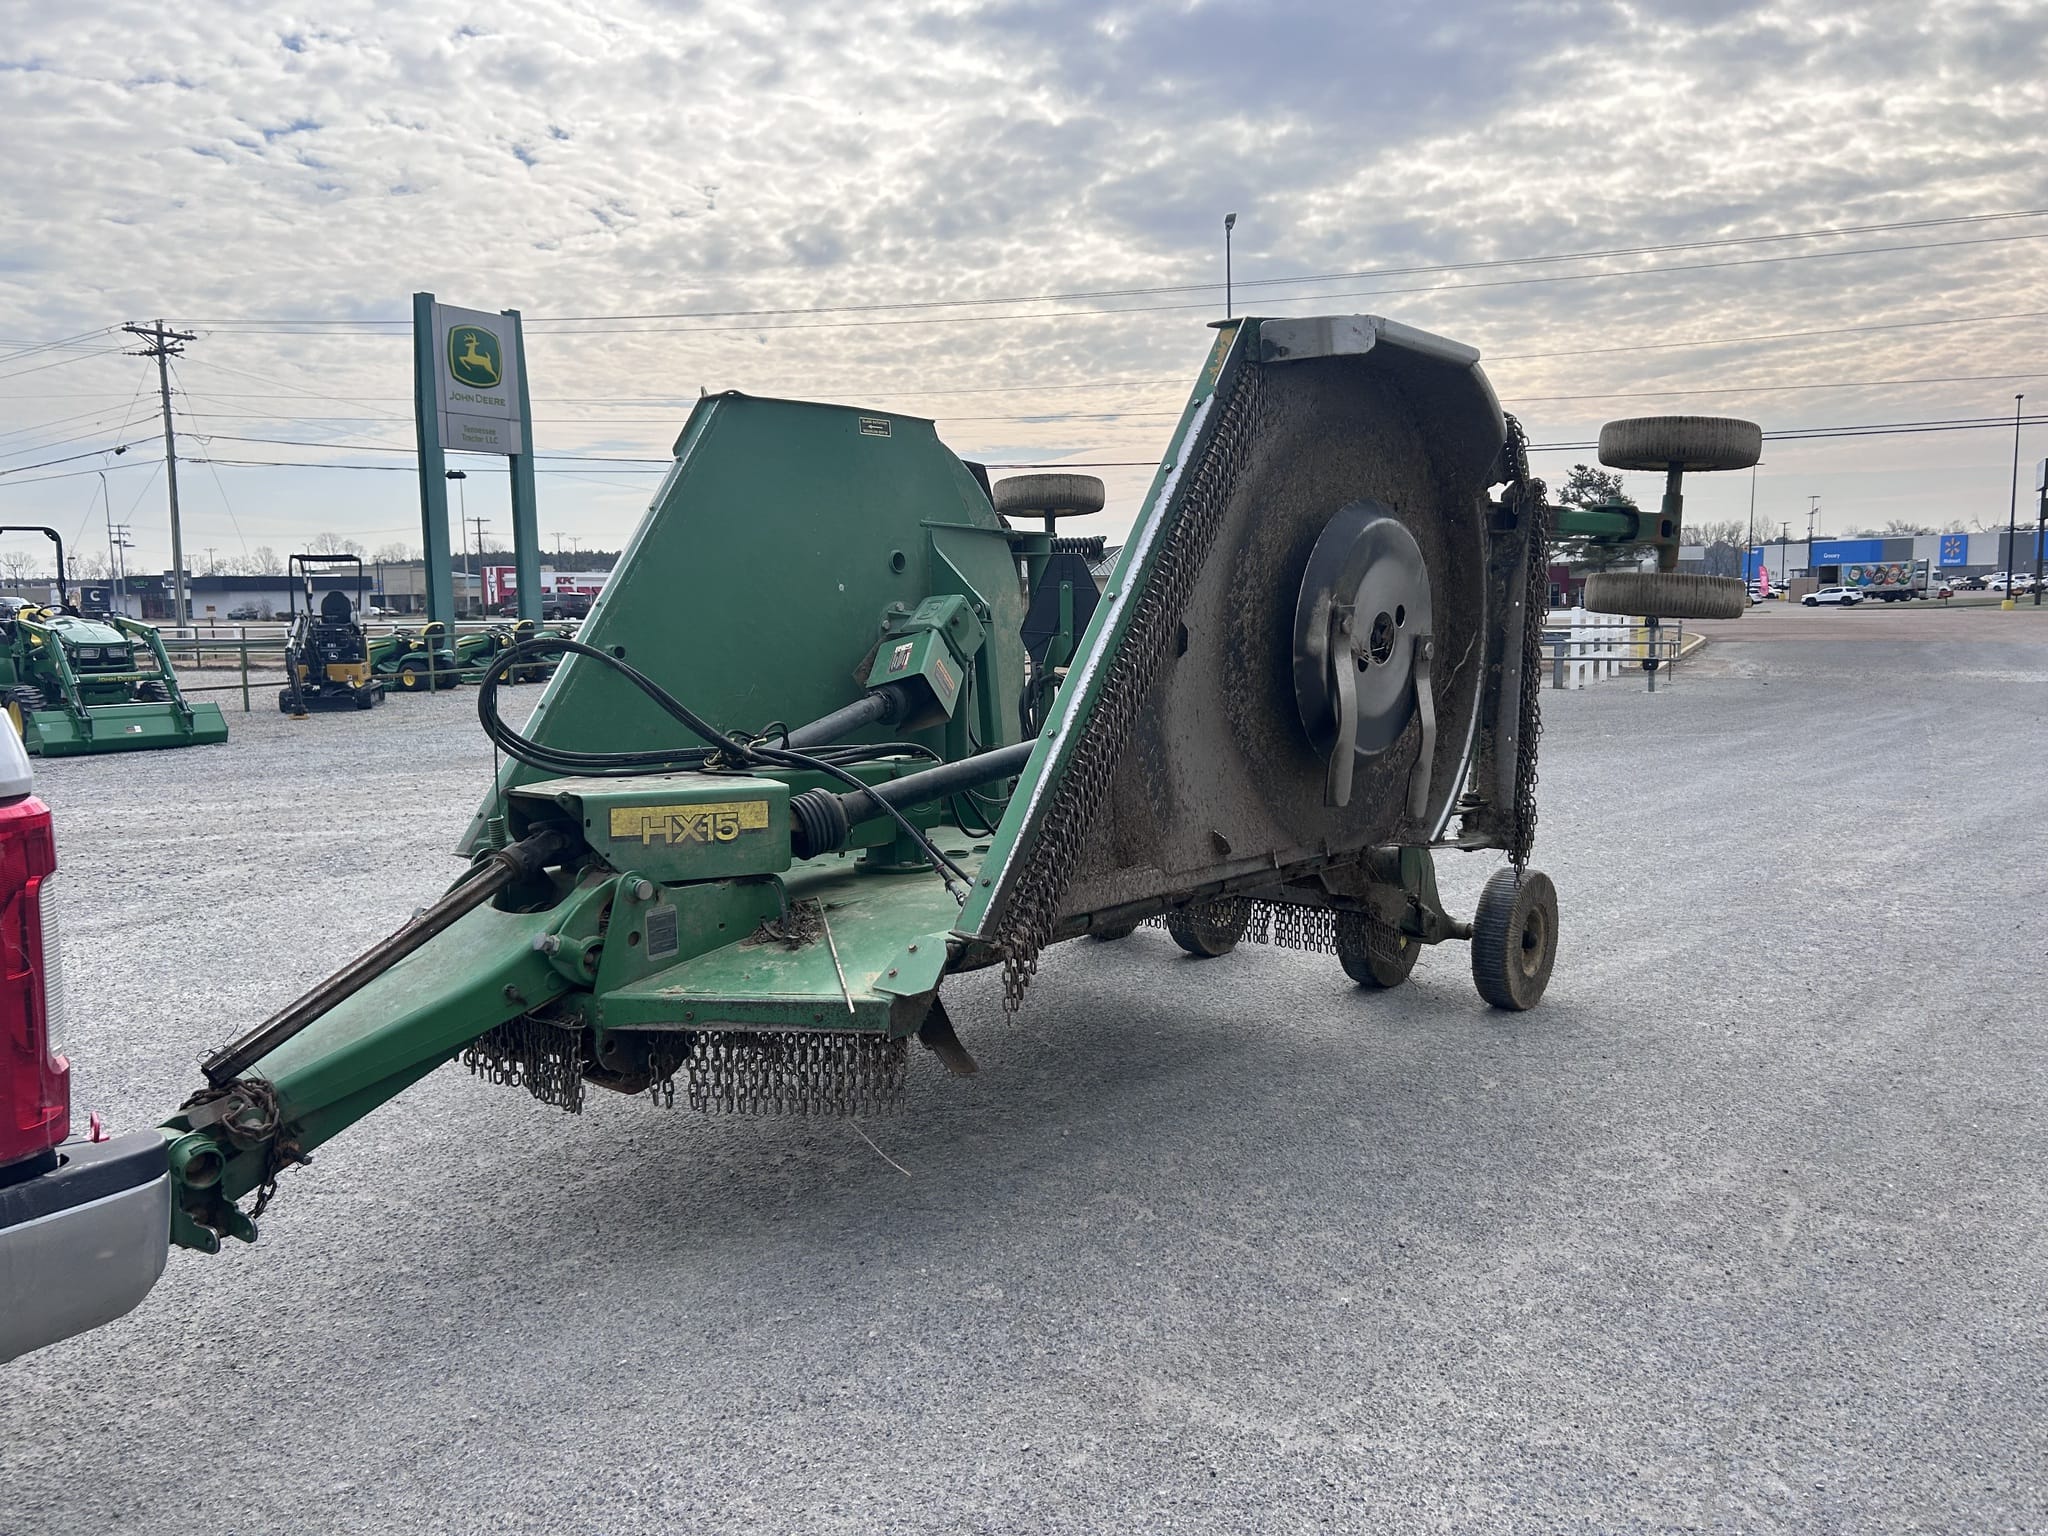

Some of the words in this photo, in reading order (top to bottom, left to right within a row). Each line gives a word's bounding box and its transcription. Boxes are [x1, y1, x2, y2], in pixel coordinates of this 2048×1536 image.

[449, 391, 475, 402] JOHN
[475, 393, 506, 407] DEERE
[555, 576, 575, 585] KFC
[641, 811, 740, 846] HX15
